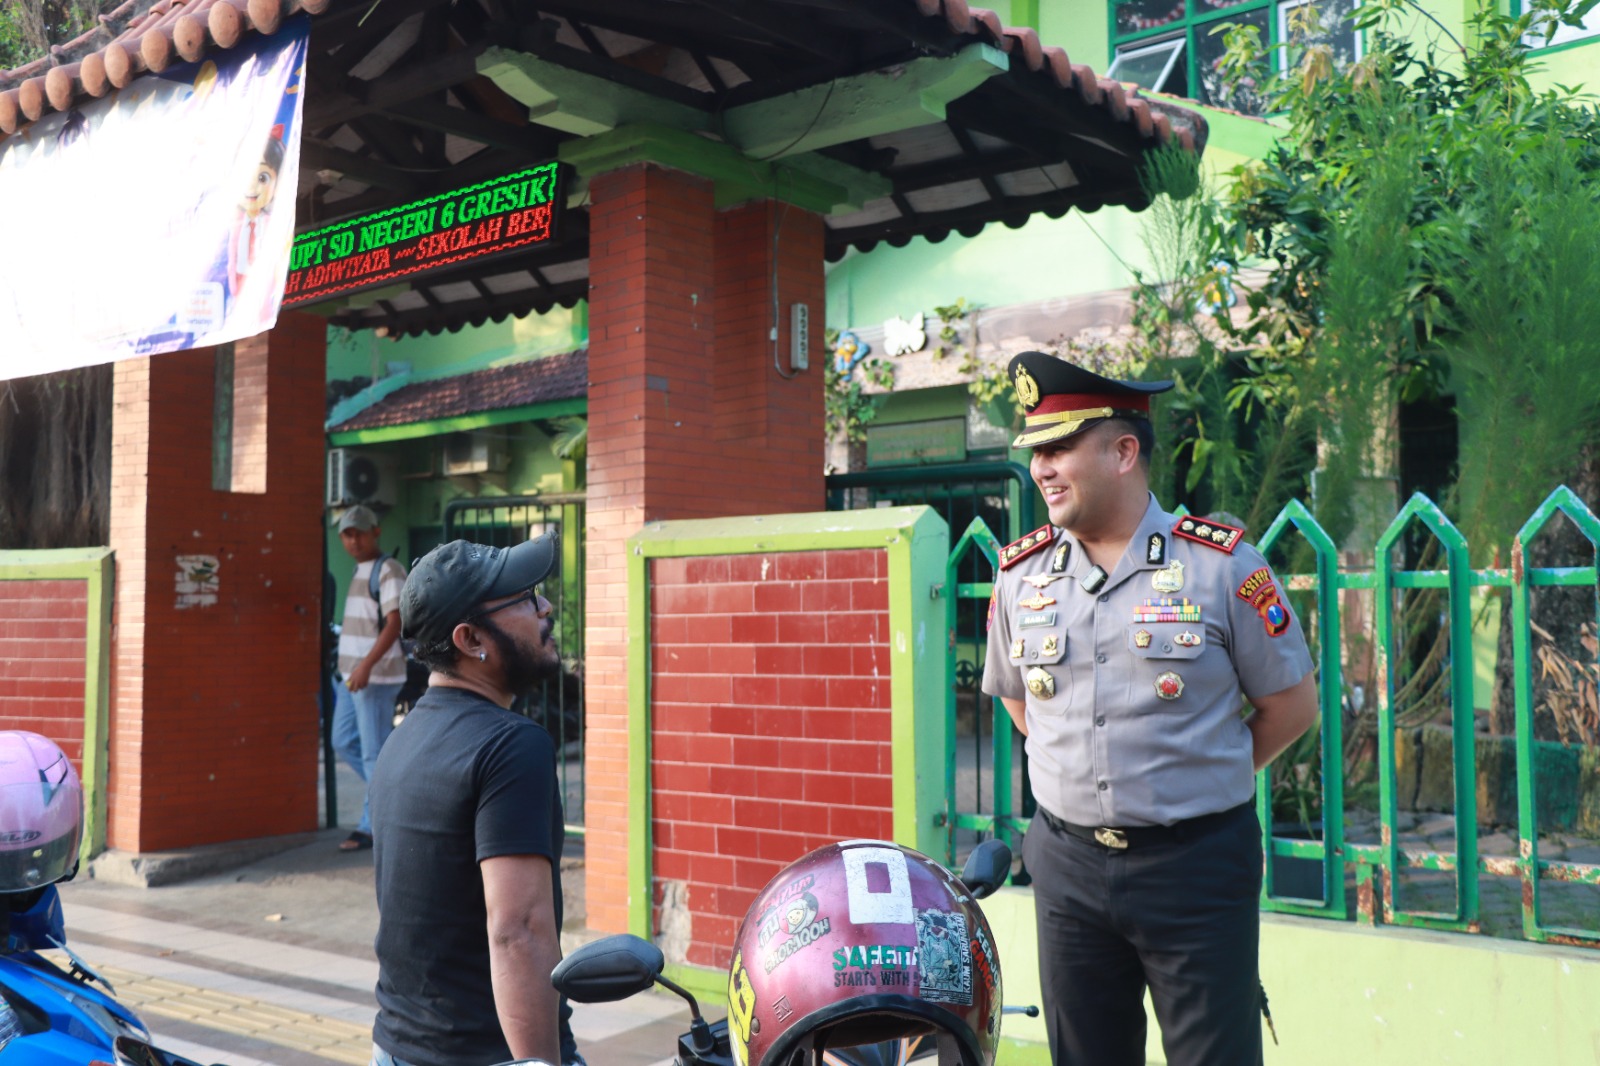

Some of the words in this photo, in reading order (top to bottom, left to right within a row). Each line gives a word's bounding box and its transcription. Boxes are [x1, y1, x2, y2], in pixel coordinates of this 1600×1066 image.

[328, 230, 355, 261] SD
[358, 207, 437, 254] NEGERI
[440, 201, 456, 229] 6
[458, 176, 549, 223] GRESIK
[302, 247, 391, 291] ADIWIYATA
[415, 217, 504, 261] SEKOLAH
[834, 970, 877, 988] STARTS
[880, 970, 910, 986] WITH
[963, 965, 971, 994] KAUM
